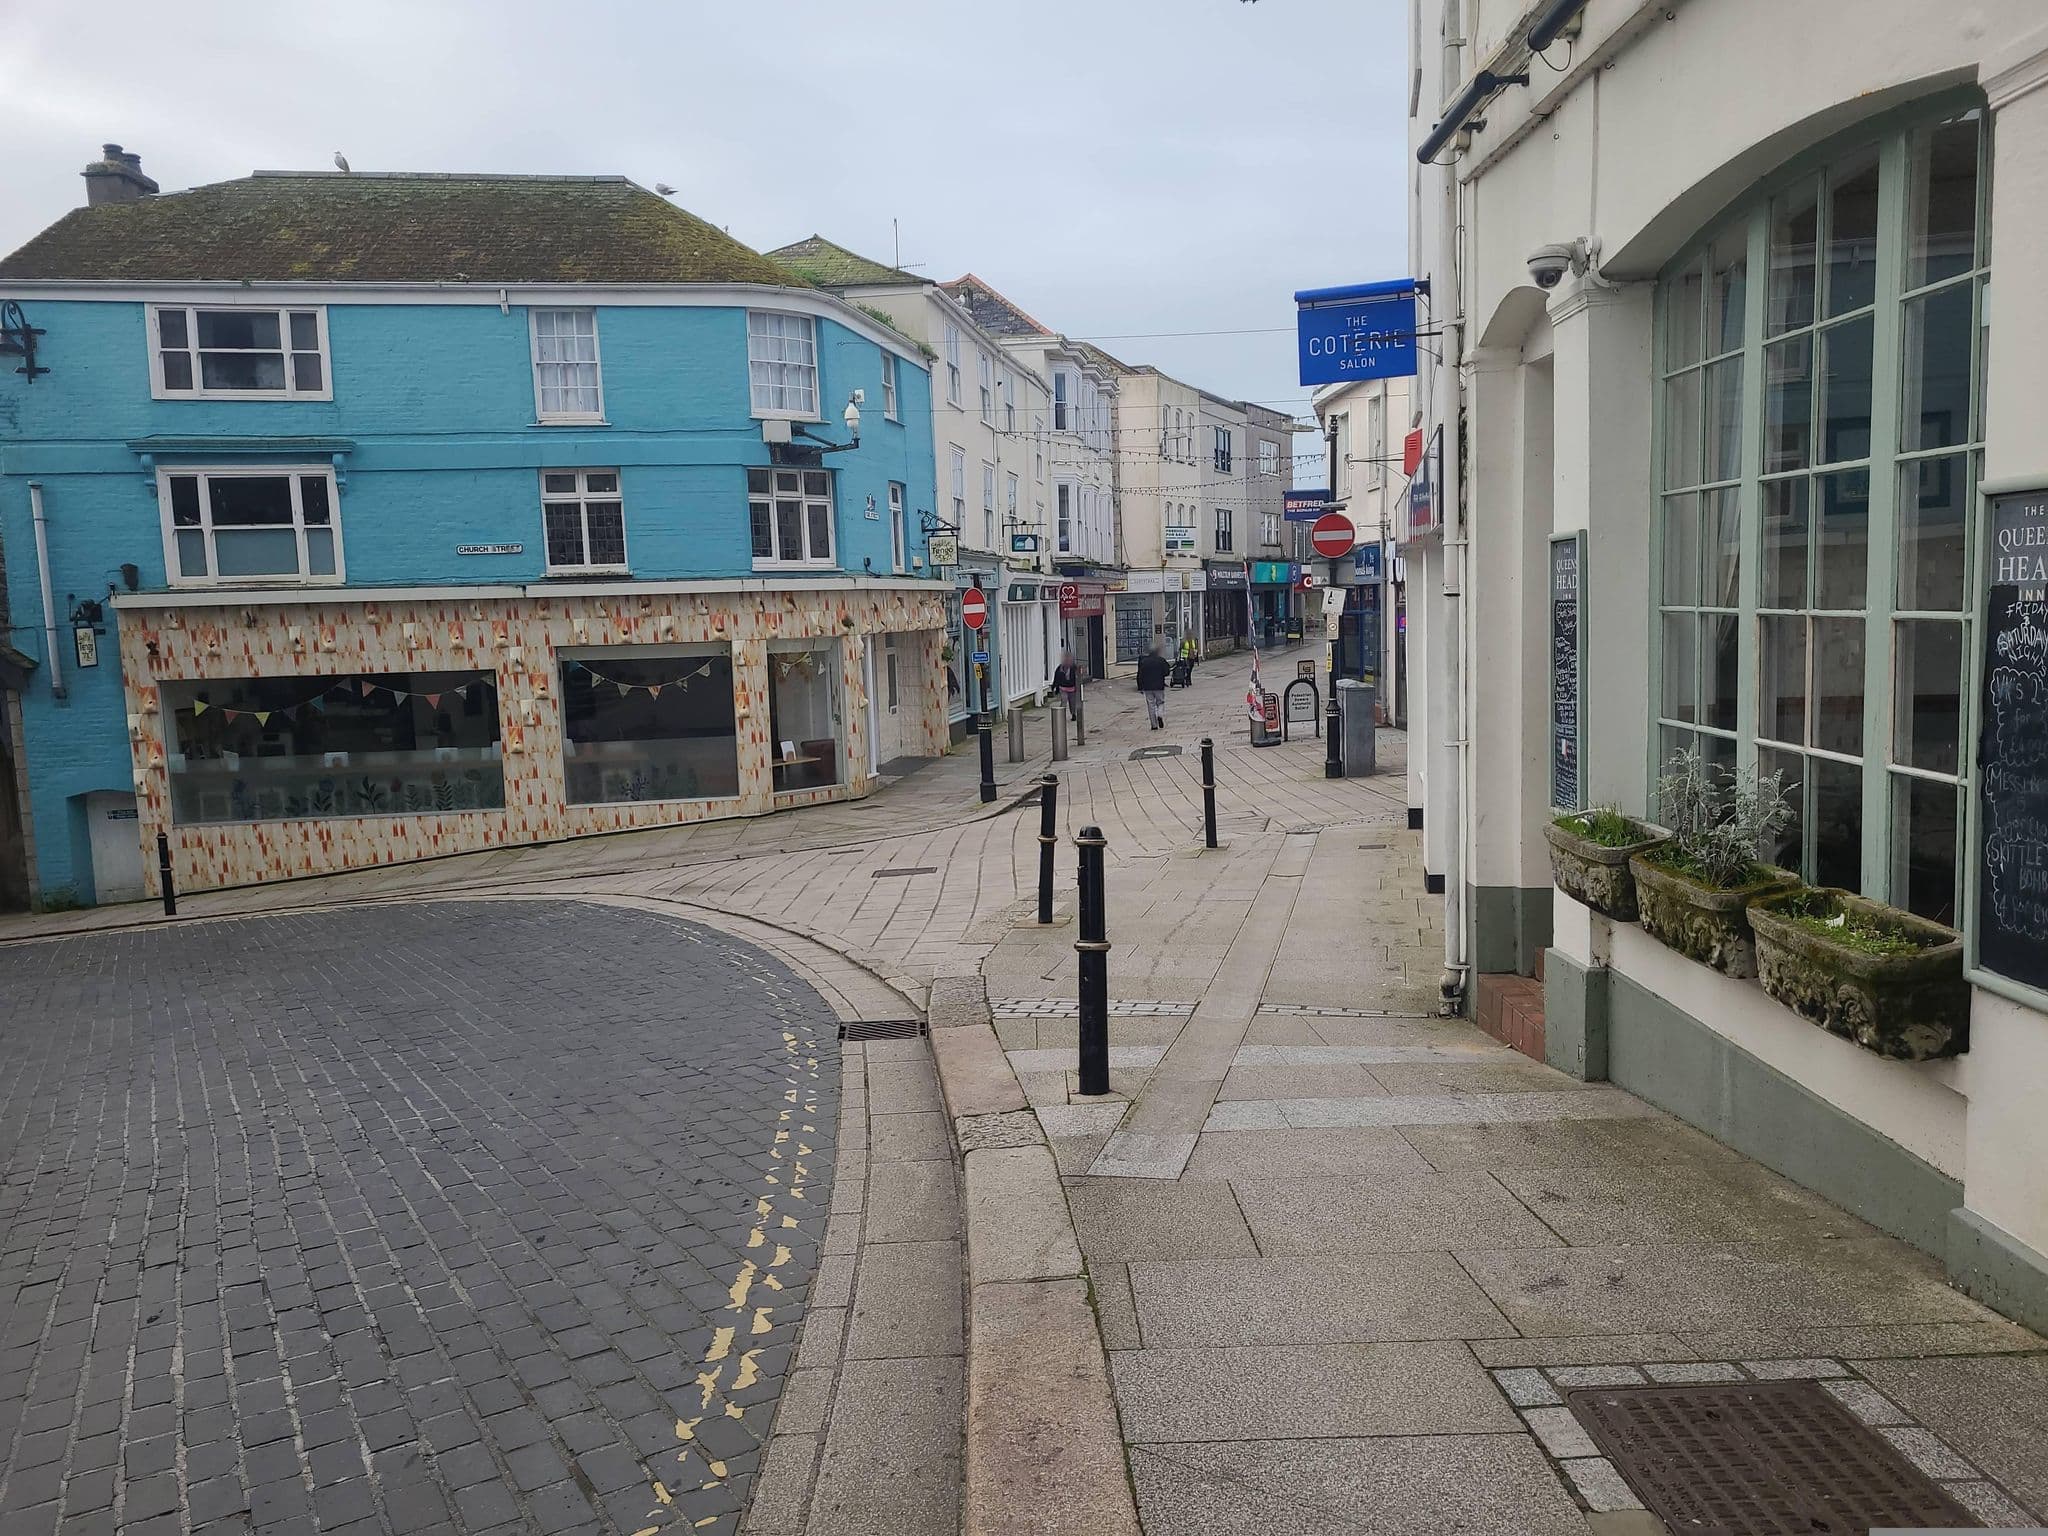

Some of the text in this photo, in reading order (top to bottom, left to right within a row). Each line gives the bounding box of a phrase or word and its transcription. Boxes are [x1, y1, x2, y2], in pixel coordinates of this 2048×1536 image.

[1346, 316, 1368, 326] THE
[1309, 329, 1406, 356] COTERIE
[1340, 357, 1376, 370] SALON
[2025, 505, 2045, 516] THE
[1999, 526, 2048, 552] QUEE
[459, 545, 488, 553] CHURCH
[1556, 574, 1577, 590] HEAD
[2019, 589, 2045, 601] INN
[2006, 602, 2048, 624] FRIDAY
[1997, 623, 2048, 657] SATURDAY
[2007, 644, 2047, 677] NIGHTS
[1991, 839, 2043, 867] SKITTLE
